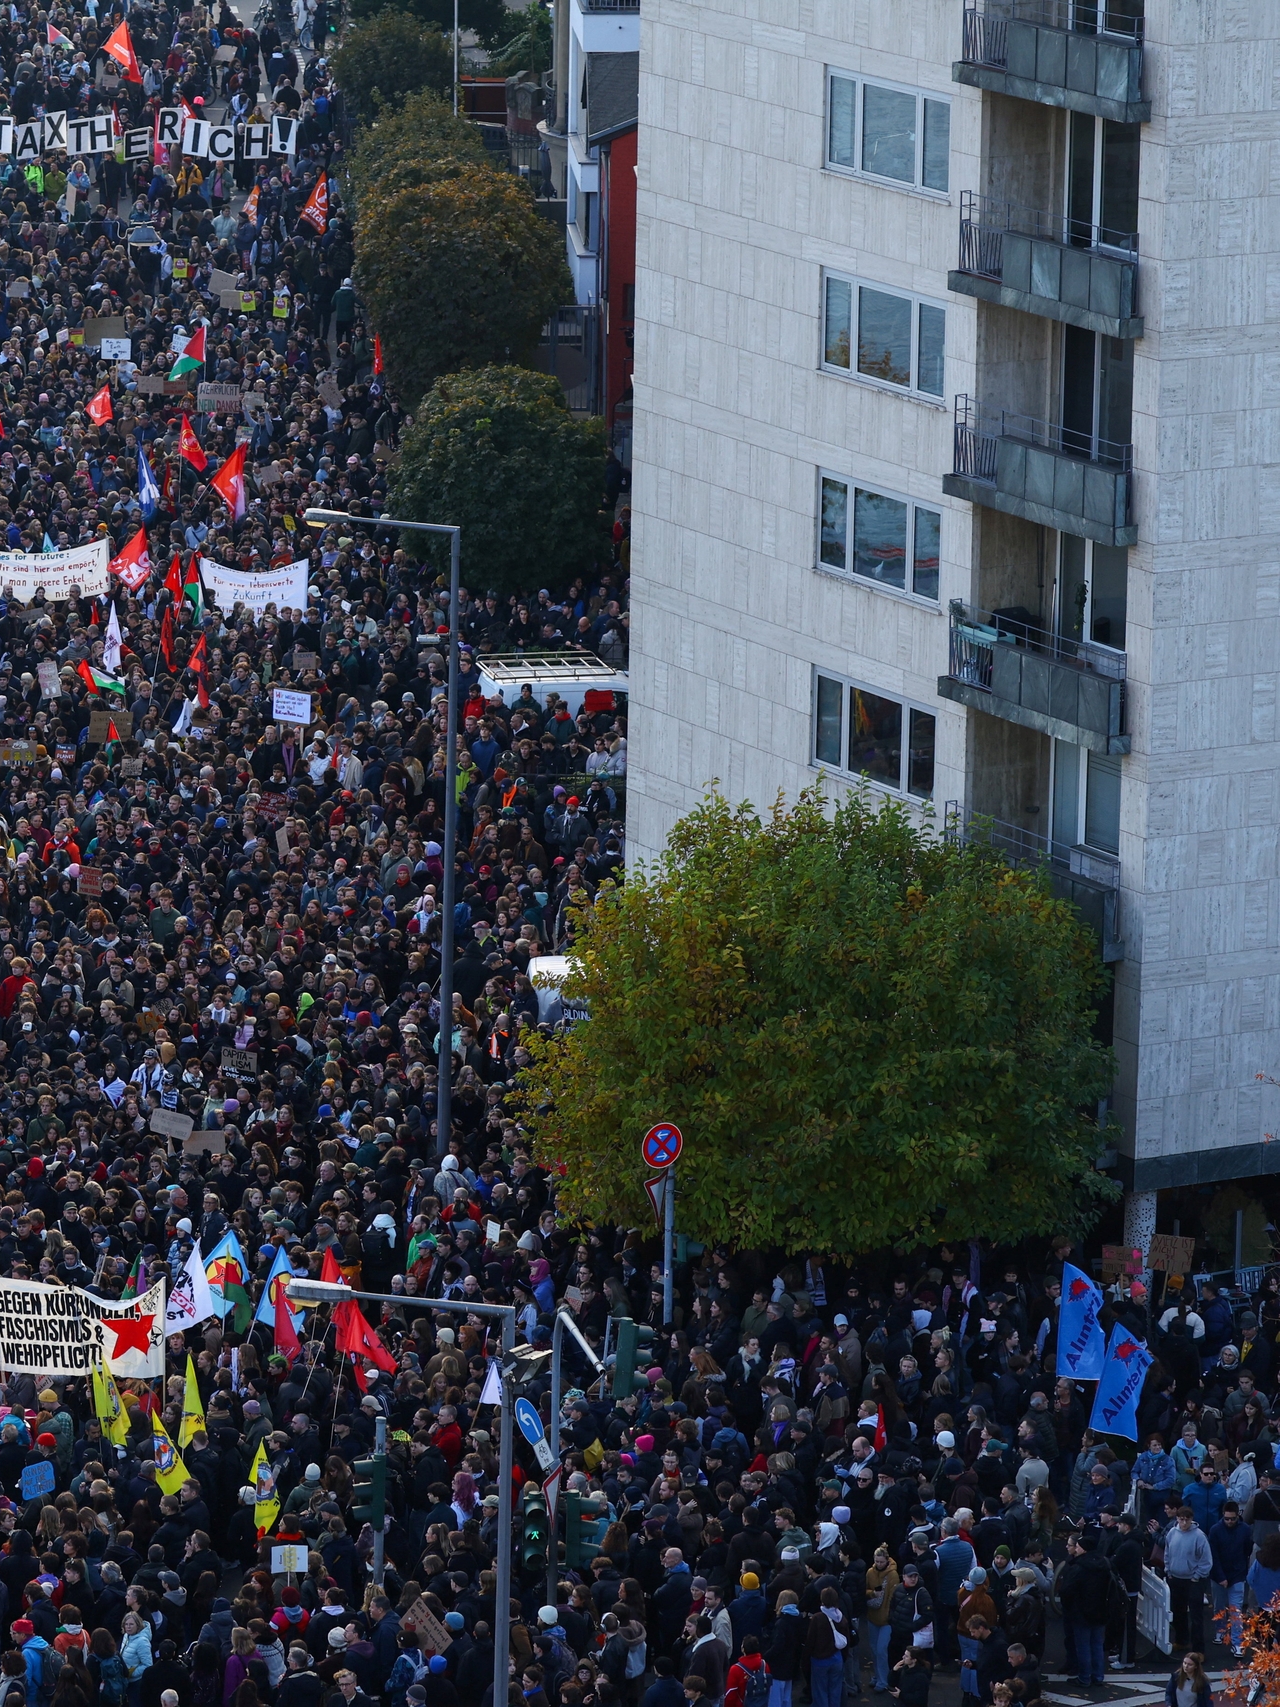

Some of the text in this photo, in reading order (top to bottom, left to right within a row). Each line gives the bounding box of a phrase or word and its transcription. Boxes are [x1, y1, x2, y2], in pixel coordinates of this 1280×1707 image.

[69, 117, 148, 158] THE
[158, 110, 294, 157] RICH!
[199, 399, 239, 413] NEIN DANKE
[14, 553, 27, 561] for
[13, 563, 29, 573] sind
[34, 564, 50, 573] hier
[52, 564, 65, 572] und
[68, 559, 97, 571] empört,
[9, 579, 27, 587] man
[33, 578, 60, 588] unsere
[63, 574, 85, 585] Enkel
[213, 576, 225, 585] Für
[249, 577, 294, 589] lebenswerte
[222, 1065, 239, 1073] LEVEL
[231, 1060, 252, 1071] LISM
[240, 1075, 255, 1083] 9000
[1152, 1243, 1177, 1254] NICHT
[1181, 1237, 1196, 1248] IST
[44, 1289, 141, 1321] KÜRZUNGEN,
[94, 1325, 105, 1346] &
[1, 1342, 103, 1369] WEHRPFLICHT!
[416, 1601, 426, 1613] Gen
[410, 1608, 419, 1621] Gen
